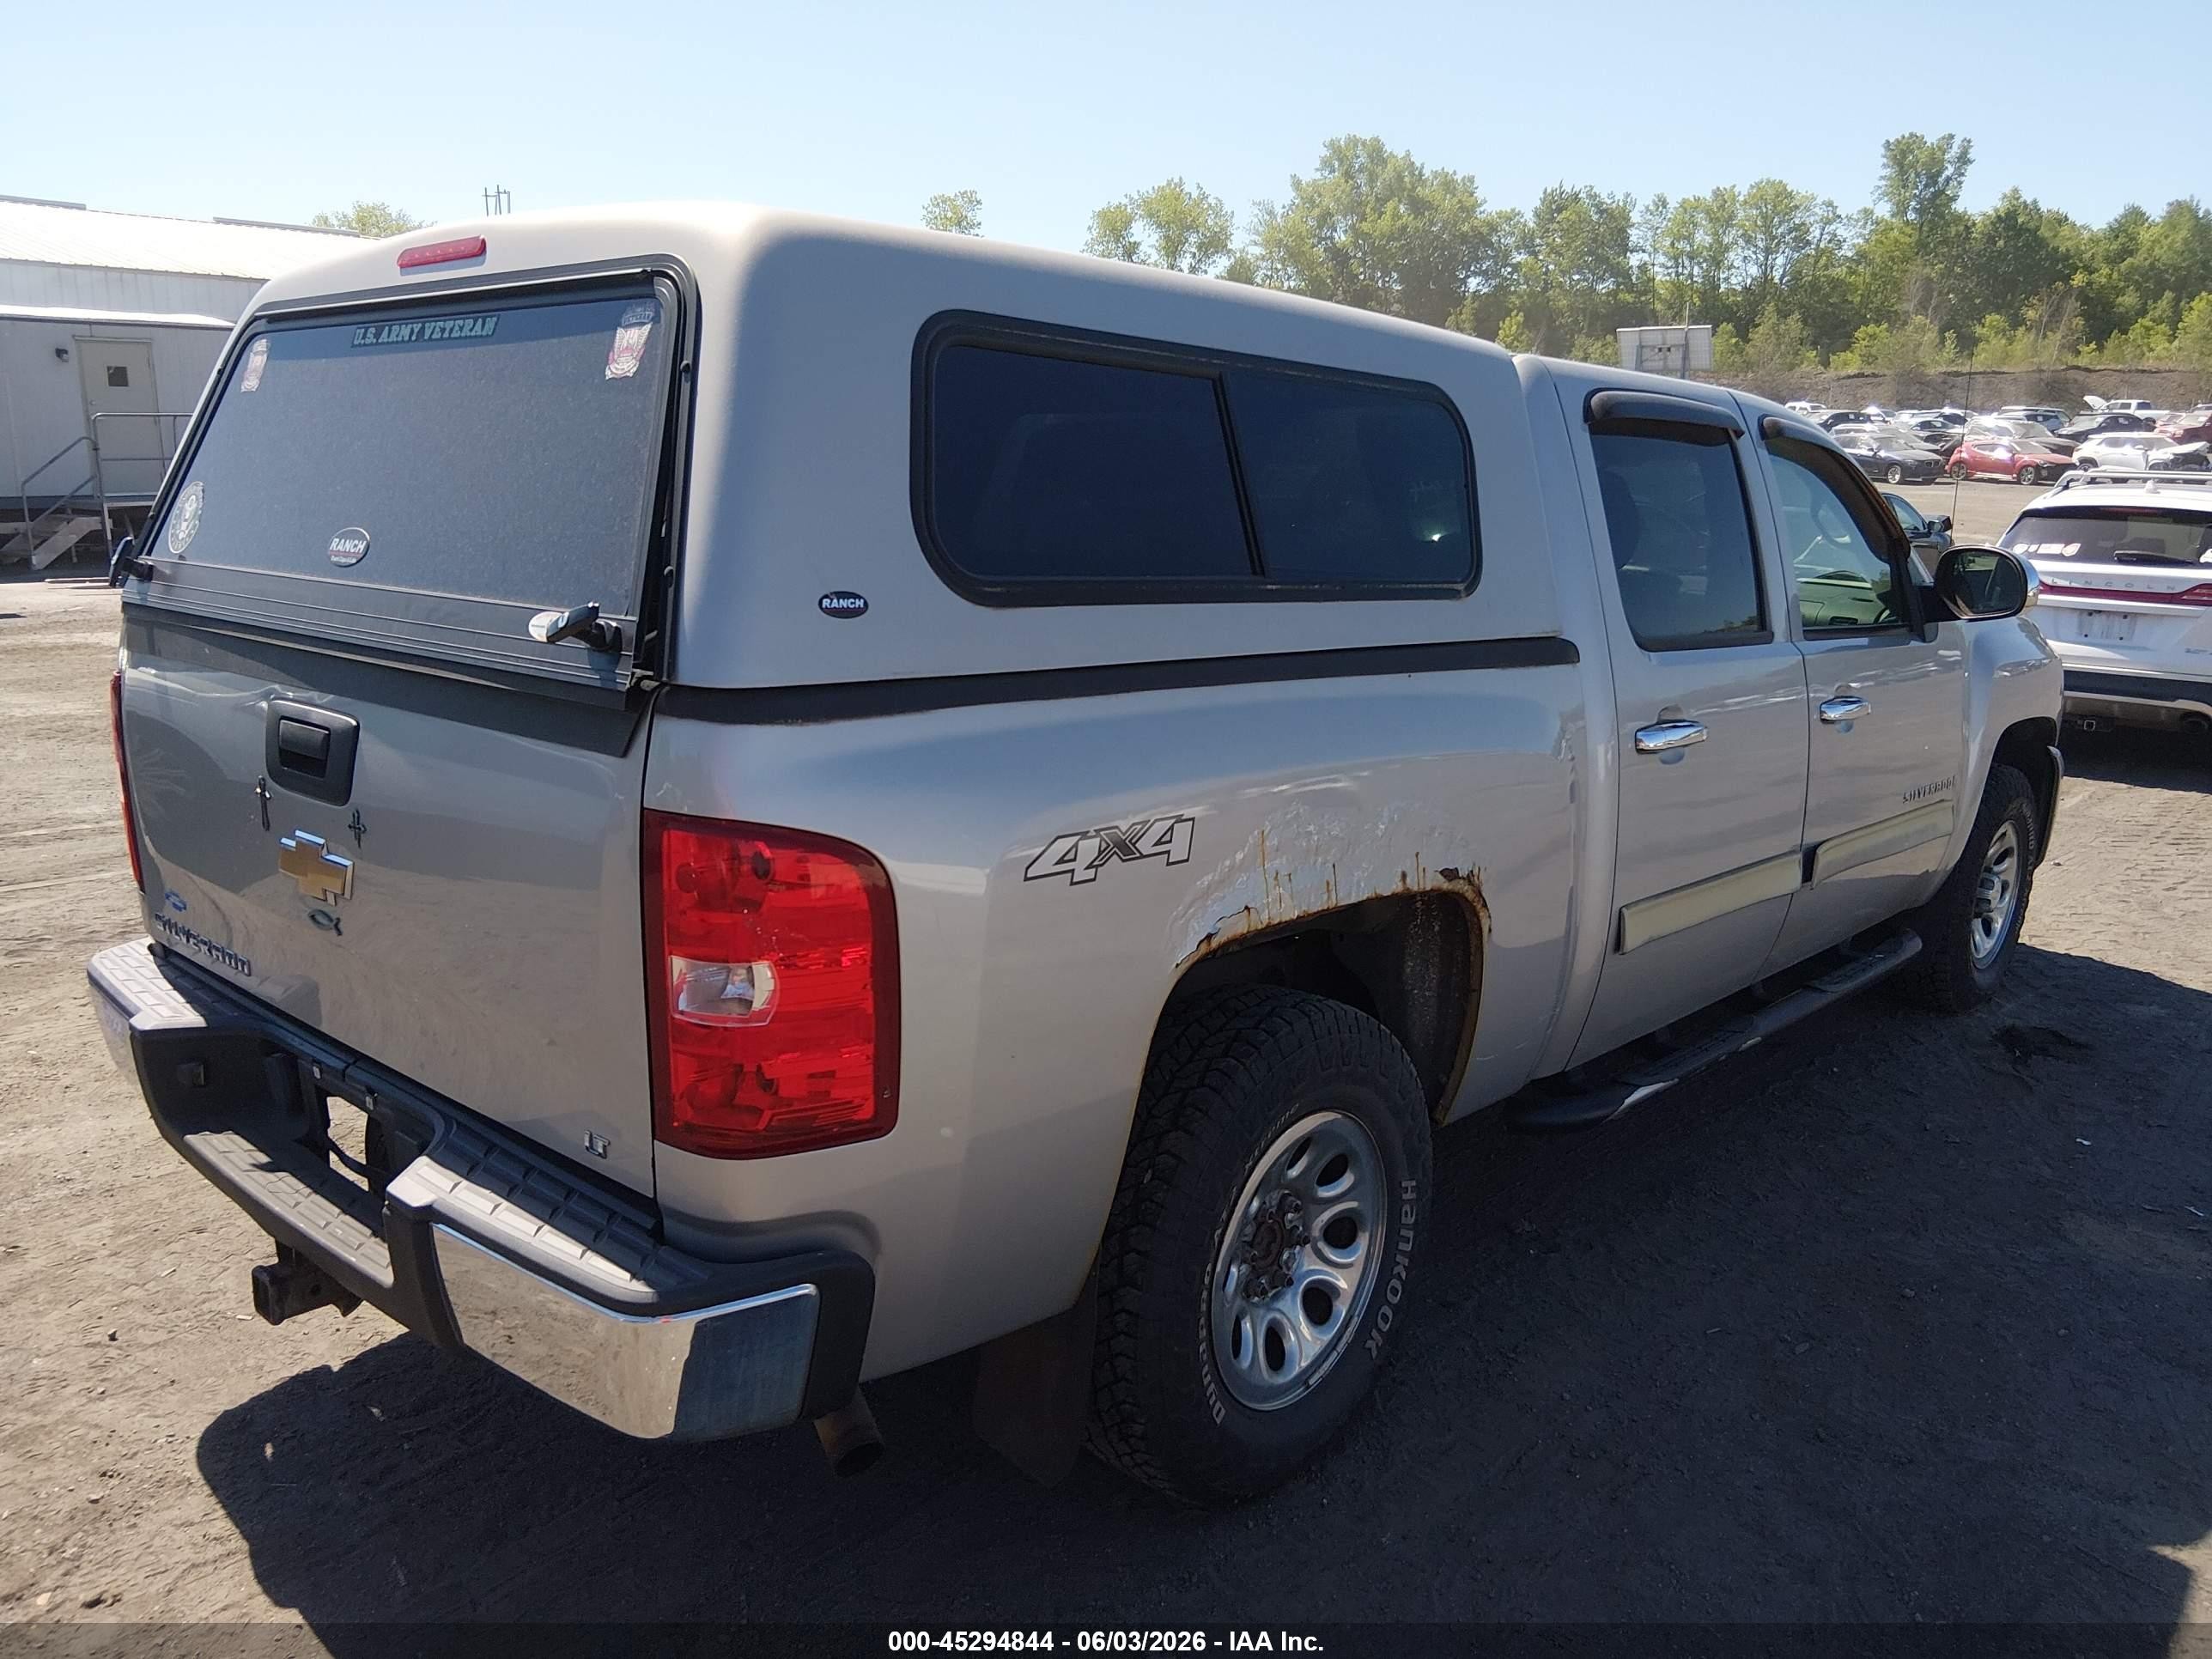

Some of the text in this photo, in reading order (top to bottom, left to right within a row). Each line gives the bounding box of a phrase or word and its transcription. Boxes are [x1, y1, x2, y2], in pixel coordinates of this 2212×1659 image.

[354, 316, 498, 345] U.S. ARMY VETERAN
[329, 538, 368, 554] RANCH
[2051, 578, 2176, 591] LINCOLN
[821, 598, 865, 609] RANCH
[584, 1129, 611, 1159] LT
